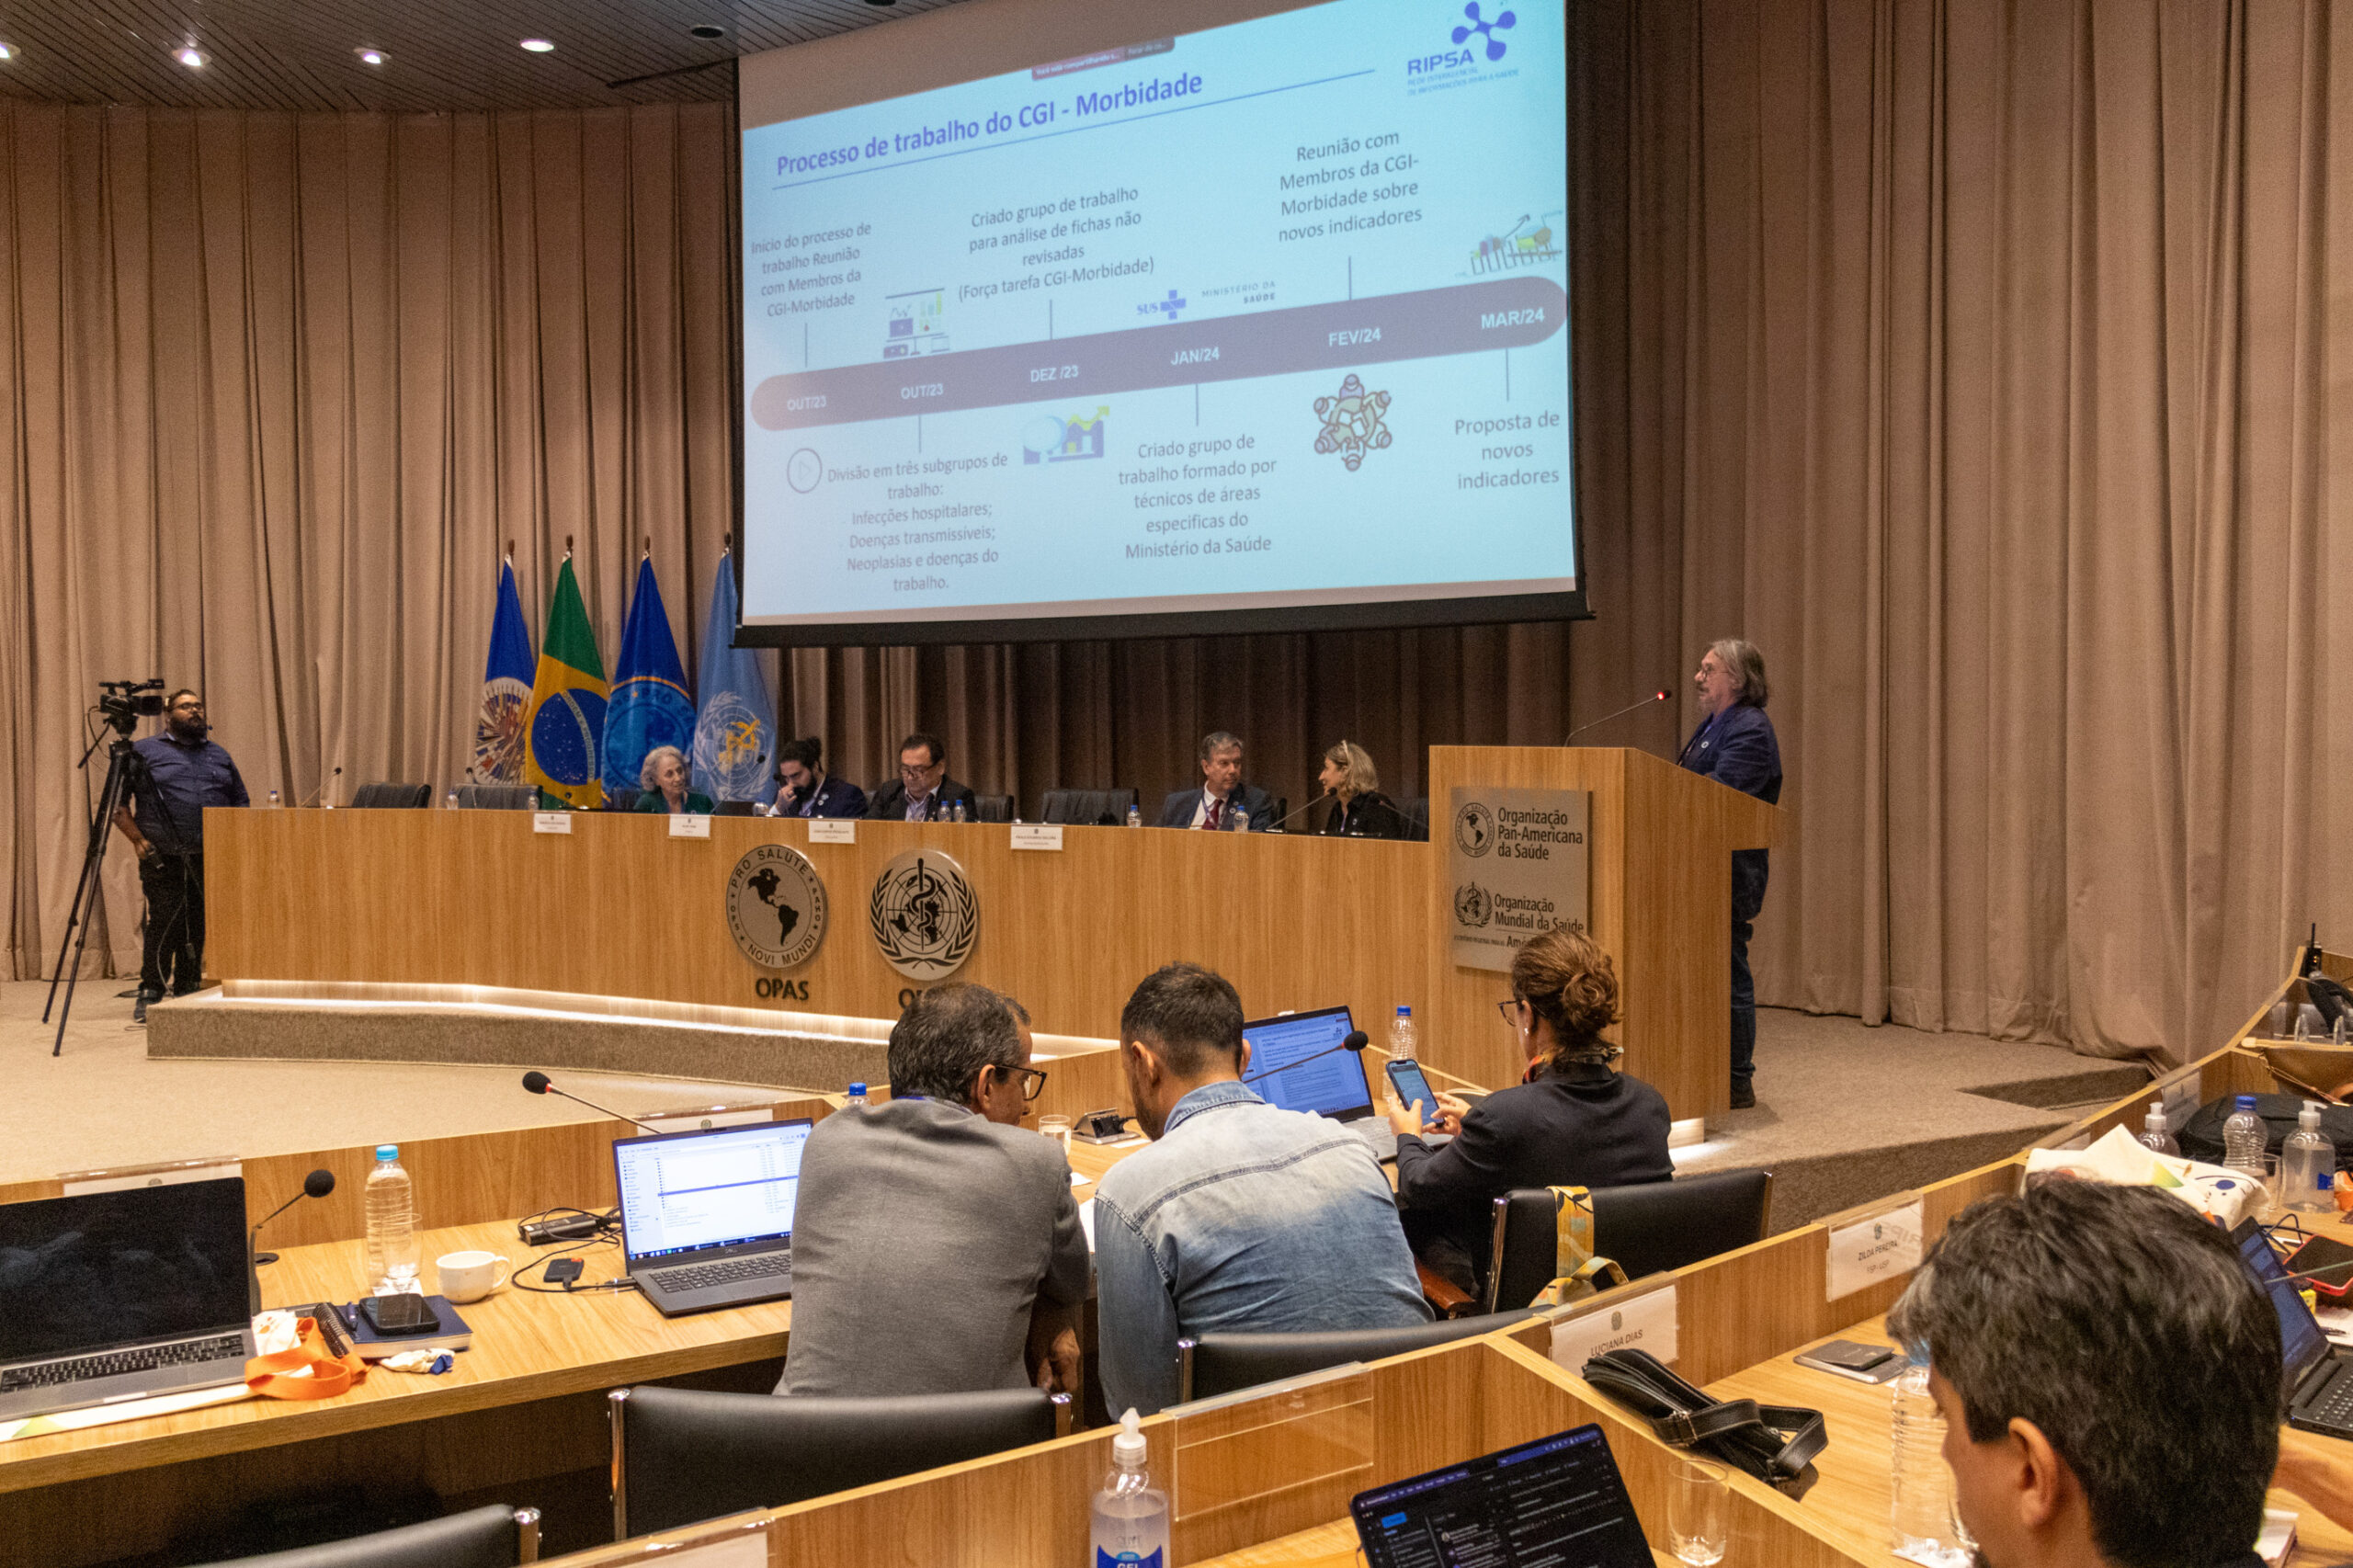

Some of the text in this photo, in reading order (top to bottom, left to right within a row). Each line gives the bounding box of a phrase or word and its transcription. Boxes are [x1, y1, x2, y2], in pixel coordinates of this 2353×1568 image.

[1407, 49, 1474, 75] RIPSA
[777, 142, 858, 176] Processo
[865, 135, 889, 159] de
[894, 119, 980, 154] trabalho
[985, 110, 1012, 137] do
[1017, 100, 1056, 129] CGI
[1075, 72, 1203, 118] Morbidade
[1297, 132, 1400, 162] Reunião com
[1279, 153, 1419, 191] Membros da CGI-
[971, 187, 1140, 229] Criado grupo de trabalho
[1281, 182, 1419, 216] Morbidade sobre
[784, 234, 799, 249] do
[801, 227, 854, 248] processo
[857, 222, 871, 236] de
[969, 210, 1142, 255] para análise de fichas não
[1279, 209, 1423, 243] novos indicadores
[762, 246, 861, 275] trabalho Reunião
[1022, 245, 1086, 267] revisadas
[761, 268, 862, 296] com Membros da
[959, 256, 1154, 303] (Força tarefa CGI-Morbidade)
[1263, 279, 1276, 290] DA
[767, 292, 856, 317] CGI-Morbidade
[1137, 301, 1158, 315] SUS
[1481, 307, 1546, 331] MAR/24
[1328, 327, 1382, 348] FEV/24
[1170, 346, 1221, 366] JAN/24
[1030, 365, 1079, 382] DEZ /23
[901, 382, 944, 401] OUT/23
[787, 395, 827, 413] OUT/23
[1455, 410, 1560, 437] Proposta de
[1138, 434, 1256, 459] Criado grupo de
[1482, 444, 1533, 460] novos
[827, 452, 1008, 483] Divisão em três subgrupos de
[1118, 460, 1278, 485] trabalho formado por
[1458, 469, 1560, 490] indicadores
[888, 483, 944, 500] trabalho:
[1134, 485, 1261, 509] técnicos de áreas
[852, 503, 993, 527] Infecções hospitalares;
[1229, 511, 1248, 527] do
[849, 533, 901, 550] Doenças
[1125, 536, 1272, 560] Ministério da Saúde
[847, 548, 999, 573] Neoplasias e doenças do
[893, 574, 949, 592] trabalho.
[1497, 807, 1568, 827] Organização
[1497, 825, 1583, 845] Pan-Americana
[1497, 842, 1511, 858] da
[1515, 842, 1550, 860] Saúde
[731, 848, 809, 889] PRO SALUTE
[1495, 893, 1554, 915] Organização
[1495, 912, 1584, 933] Mundial da Saúde
[747, 934, 816, 965] NOVI MUNDI
[756, 977, 809, 1001] OPAS
[1858, 1240, 1898, 1262] ZILDA PEREIRA
[1591, 1329, 1643, 1357] LUCIANA DIAS
